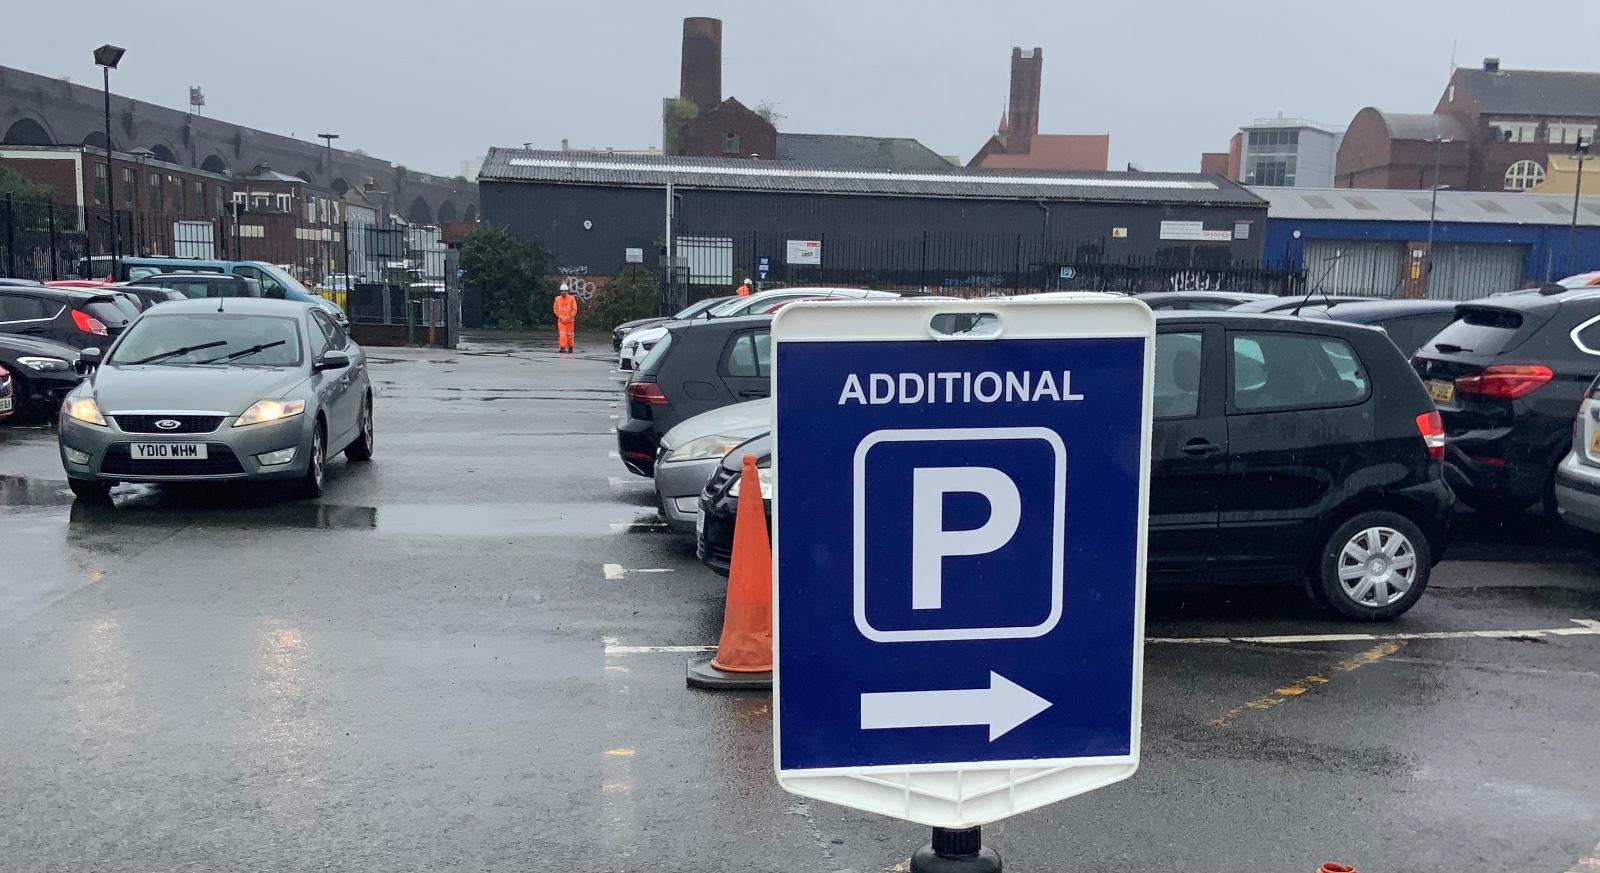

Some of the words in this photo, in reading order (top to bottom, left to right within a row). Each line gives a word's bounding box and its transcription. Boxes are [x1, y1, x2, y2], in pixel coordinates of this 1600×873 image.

[838, 371, 1084, 405] ADDITIONAL
[138, 445, 167, 456] YD10
[171, 445, 197, 456] WHM
[912, 466, 1022, 610] P
